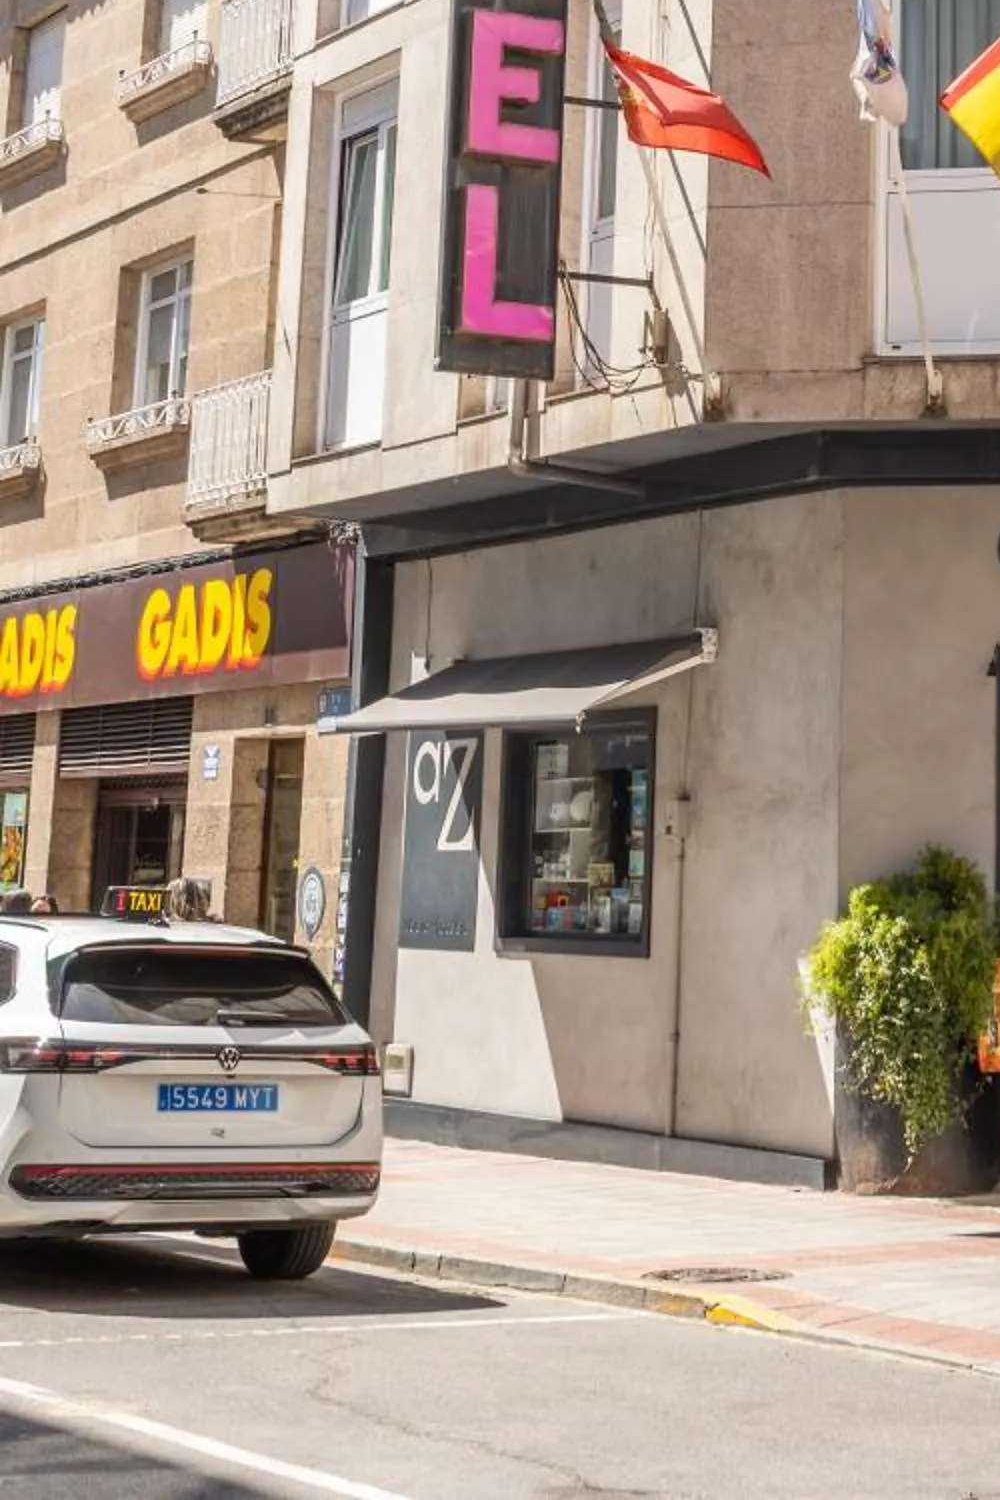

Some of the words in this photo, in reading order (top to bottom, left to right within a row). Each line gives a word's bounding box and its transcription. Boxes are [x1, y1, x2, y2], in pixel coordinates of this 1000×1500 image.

[0, 603, 77, 698] ADIS
[138, 568, 273, 681] GADIS
[128, 891, 161, 912] TAXI
[172, 1087, 227, 1109] 5549
[234, 1087, 273, 1109] MYT
